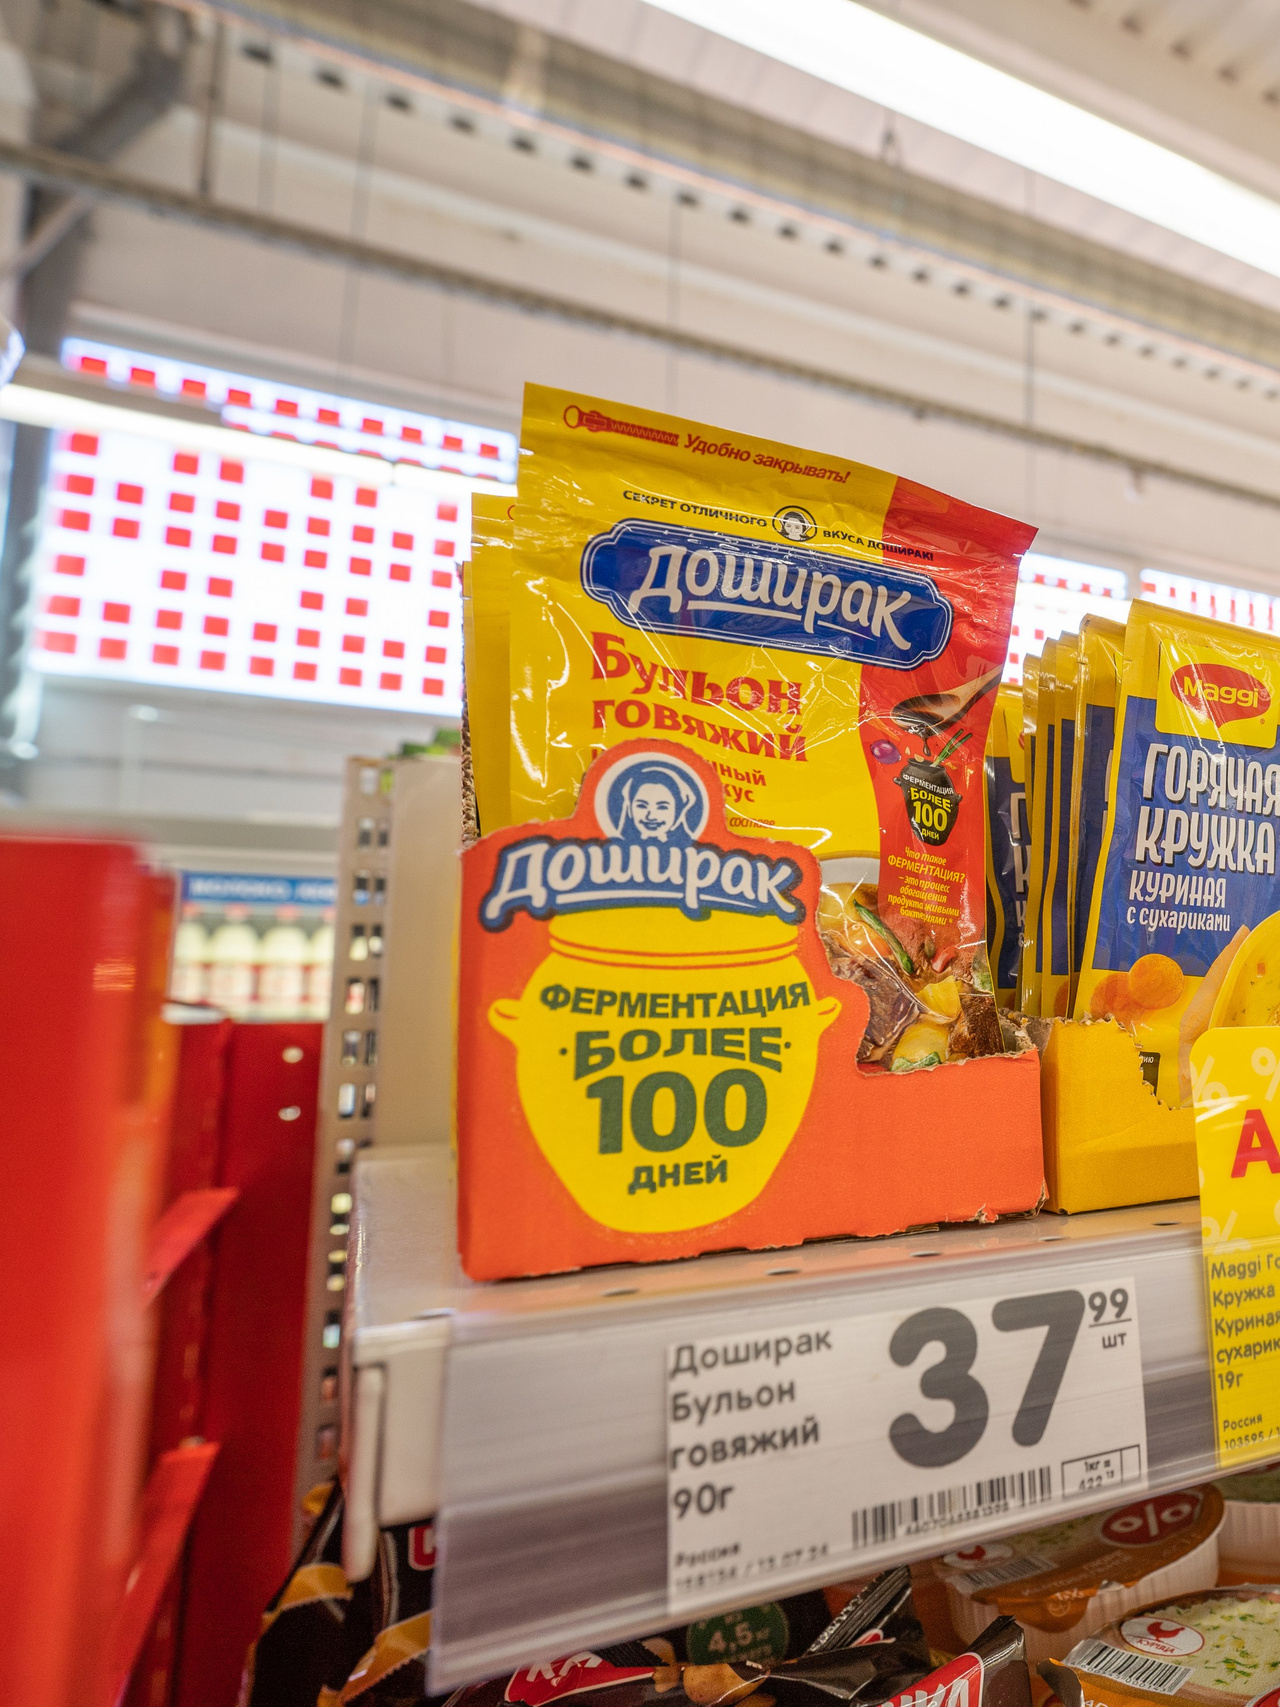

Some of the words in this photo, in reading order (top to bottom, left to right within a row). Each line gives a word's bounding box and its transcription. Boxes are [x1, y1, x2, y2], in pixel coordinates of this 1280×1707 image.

[684, 433, 751, 463] Удобно
[753, 453, 852, 485] закрывать!
[623, 490, 677, 511] СЕКРЕТ
[680, 501, 768, 528] ОТЛИЧНОГО
[822, 530, 865, 546] ВКУСА
[867, 538, 934, 562] ДОШИРАК!
[628, 545, 912, 650] Доширак
[590, 631, 802, 716] Бульон
[1183, 676, 1259, 709] Maggi
[591, 699, 808, 762] говяжий
[723, 782, 755, 803] кус
[902, 773, 954, 795] ФЕРМЕНТАЦИЯ
[910, 787, 951, 812] БОЛЕЕ
[912, 801, 948, 832] 100
[921, 851, 947, 866] такое
[1135, 806, 1275, 875] КРУЖКА
[485, 843, 798, 920] Доширак
[887, 854, 966, 884] ФЕРМЕНТАЦИЯ?
[1129, 870, 1226, 909] КУРИНАЯ
[1126, 906, 1136, 925] с
[1139, 907, 1230, 932] сухариками
[539, 981, 811, 1020] ФЕРМЕНТАЦИЯ
[586, 1068, 768, 1155] 100
[628, 1154, 728, 1195] ДНЕЙ
[1211, 1254, 1261, 1280] Maggi
[1213, 1284, 1276, 1310] Кружка
[669, 1330, 832, 1380] Доширак
[1102, 1332, 1127, 1350] шт
[888, 1289, 1086, 1469] 37
[1088, 1288, 1130, 1323] 99
[1217, 1371, 1243, 1390] 19г
[671, 1380, 795, 1426] Бульон
[1222, 1413, 1263, 1433] Россия
[1224, 1431, 1265, 1451] 103595
[670, 1415, 819, 1471] говяжий
[673, 1482, 734, 1519] 90г
